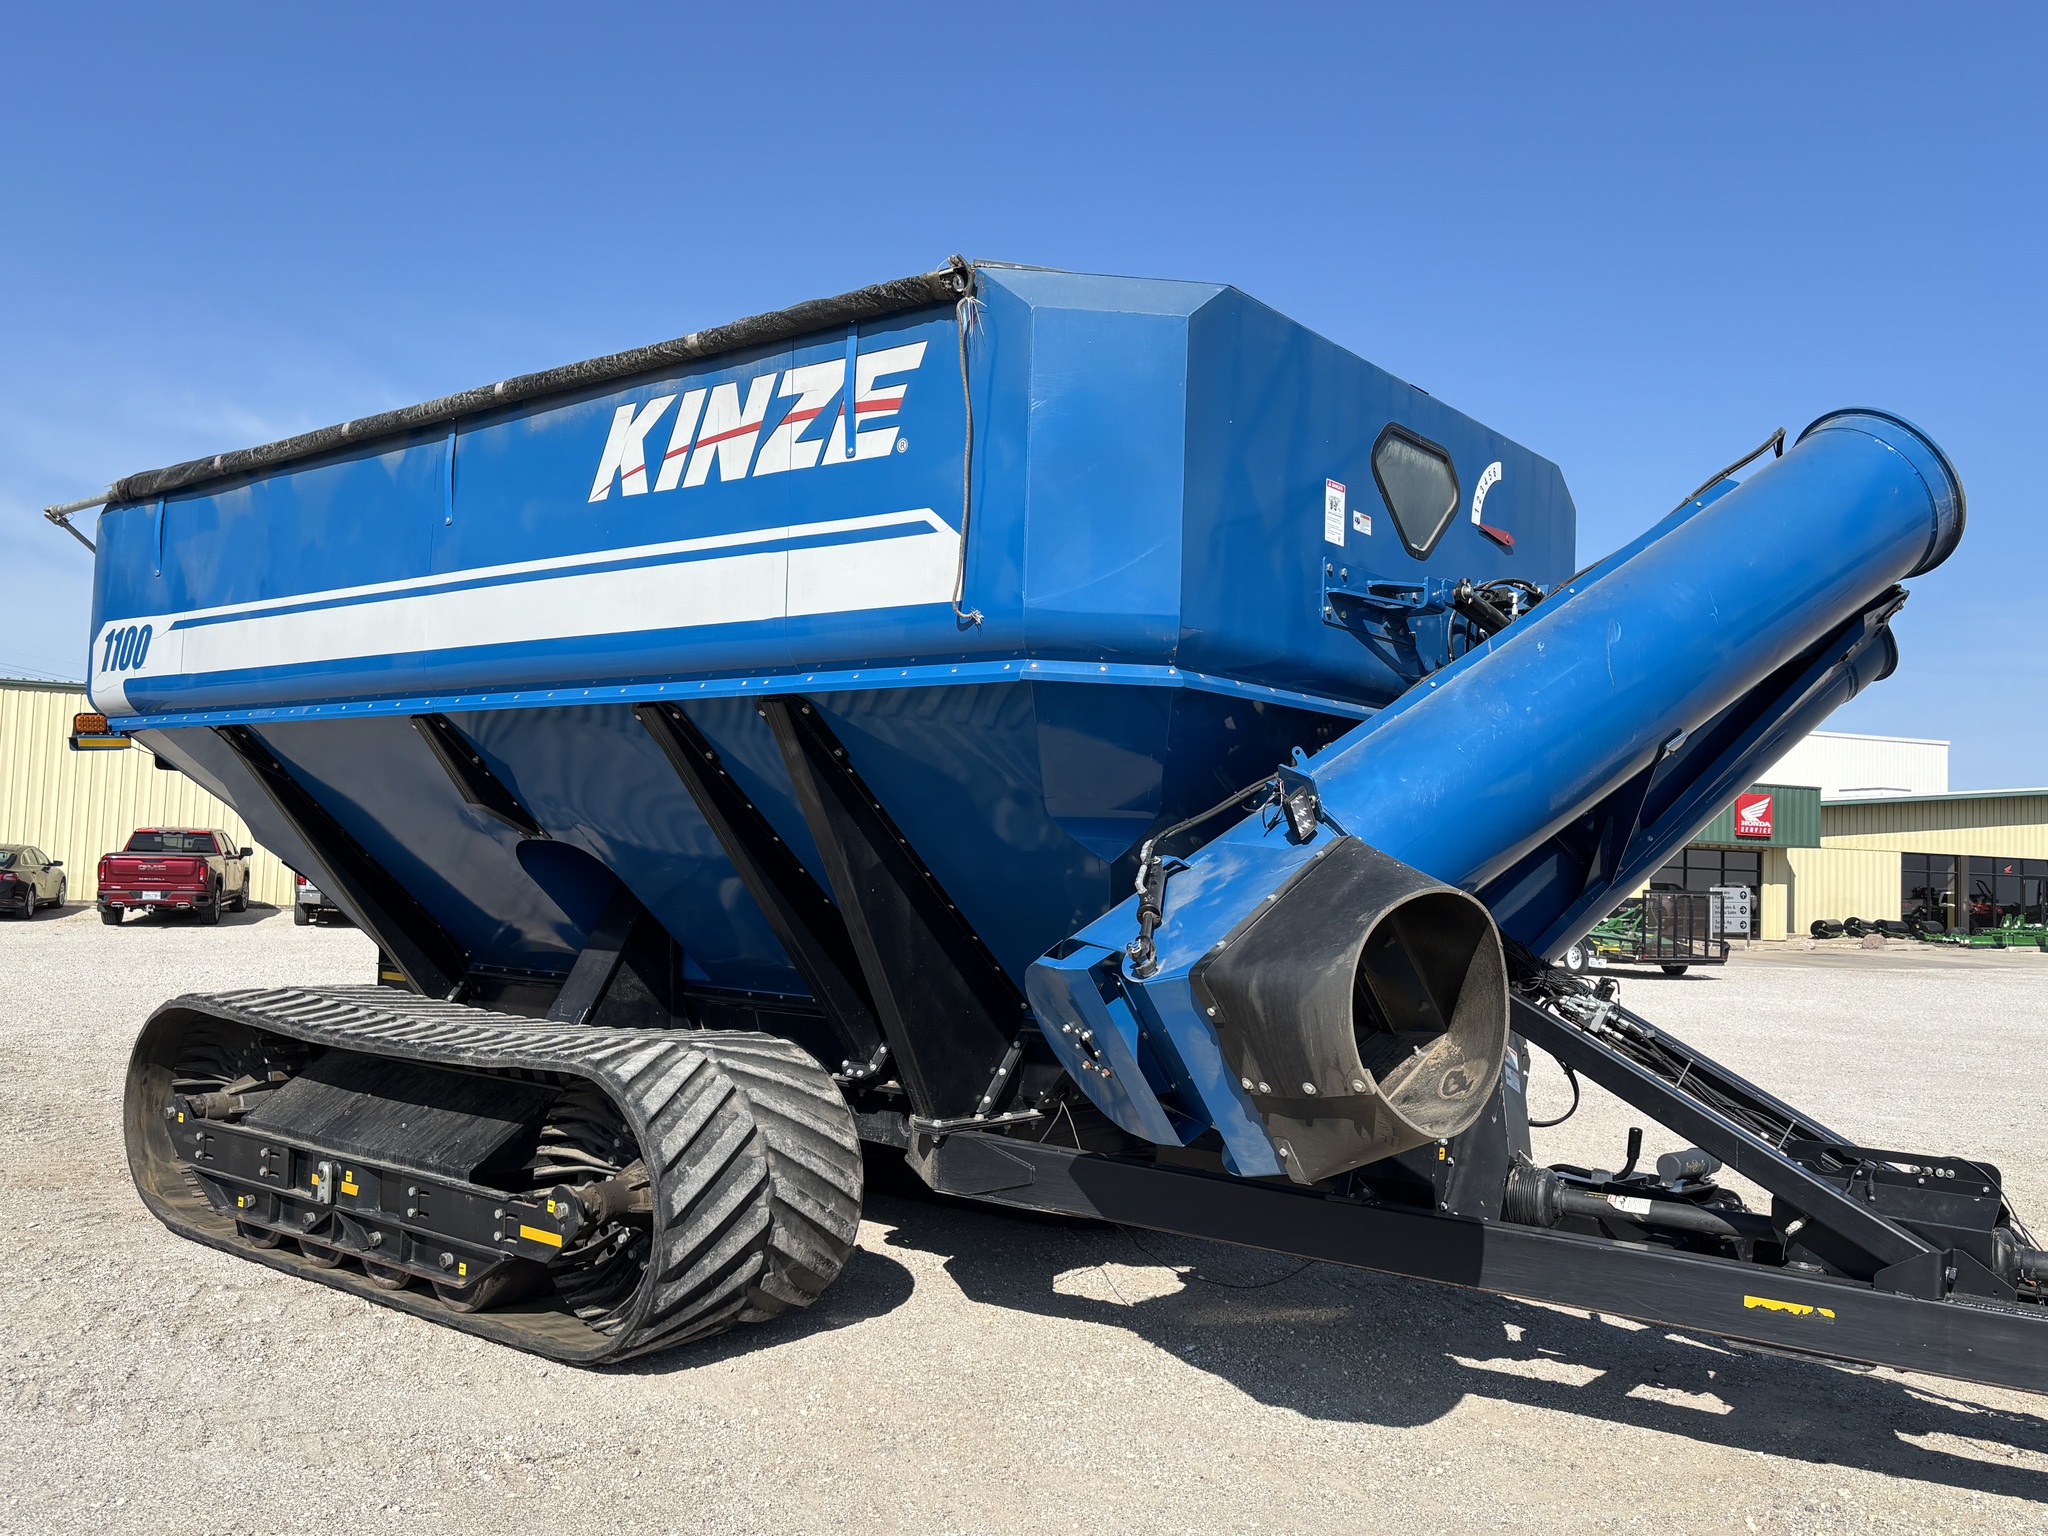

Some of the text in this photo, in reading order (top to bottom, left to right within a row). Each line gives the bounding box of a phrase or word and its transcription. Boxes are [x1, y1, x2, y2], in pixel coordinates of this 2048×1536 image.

[588, 340, 928, 503] KINZE
[101, 624, 153, 672] 1100
[1741, 820, 1772, 828] HONDA
